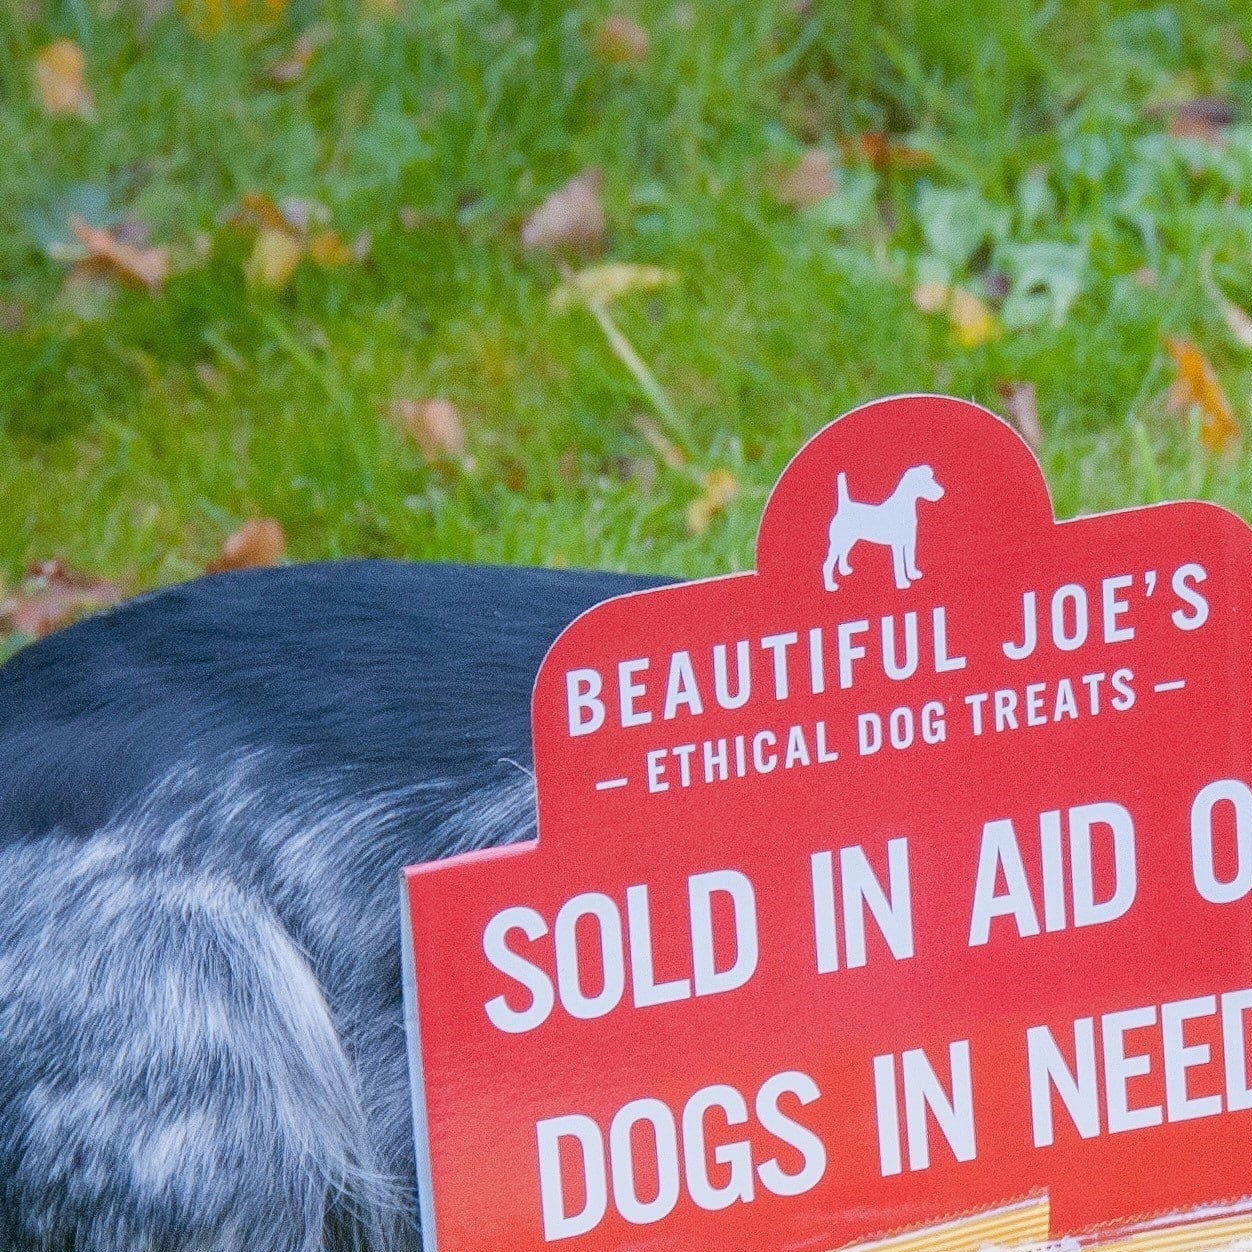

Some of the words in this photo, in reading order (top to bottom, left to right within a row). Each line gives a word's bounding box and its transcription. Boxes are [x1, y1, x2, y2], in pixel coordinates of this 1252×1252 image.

[565, 602, 969, 738] BEAUTIFUL
[1002, 562, 1212, 662] JOE'S
[645, 729, 839, 794] ETHICAL
[856, 700, 946, 757] DOG
[963, 667, 1137, 732] TREATS
[482, 868, 759, 1034] SOLD
[810, 837, 916, 976] IN
[968, 801, 1136, 947] AID
[535, 1069, 827, 1243] DOGS
[872, 1040, 979, 1178] IN
